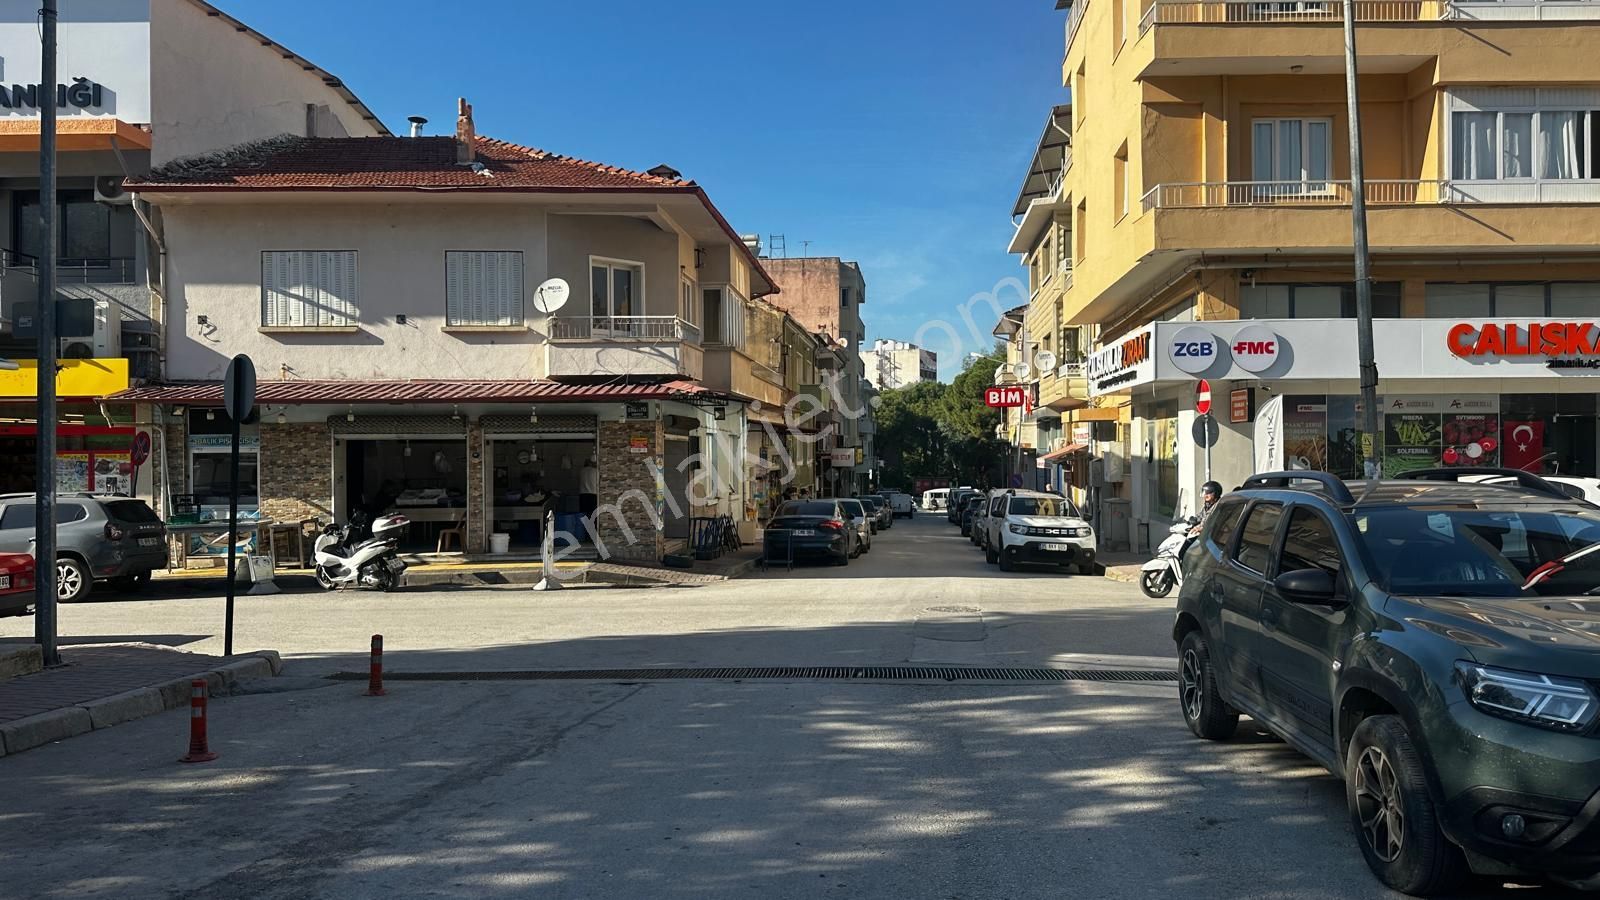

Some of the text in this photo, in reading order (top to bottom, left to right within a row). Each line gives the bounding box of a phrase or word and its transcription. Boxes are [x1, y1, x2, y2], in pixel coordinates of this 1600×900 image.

[0, 77, 101, 108] ANIĞI
[1174, 342, 1213, 357] ZGB
[1233, 342, 1275, 355] FMC
[988, 388, 1021, 404] BİM
